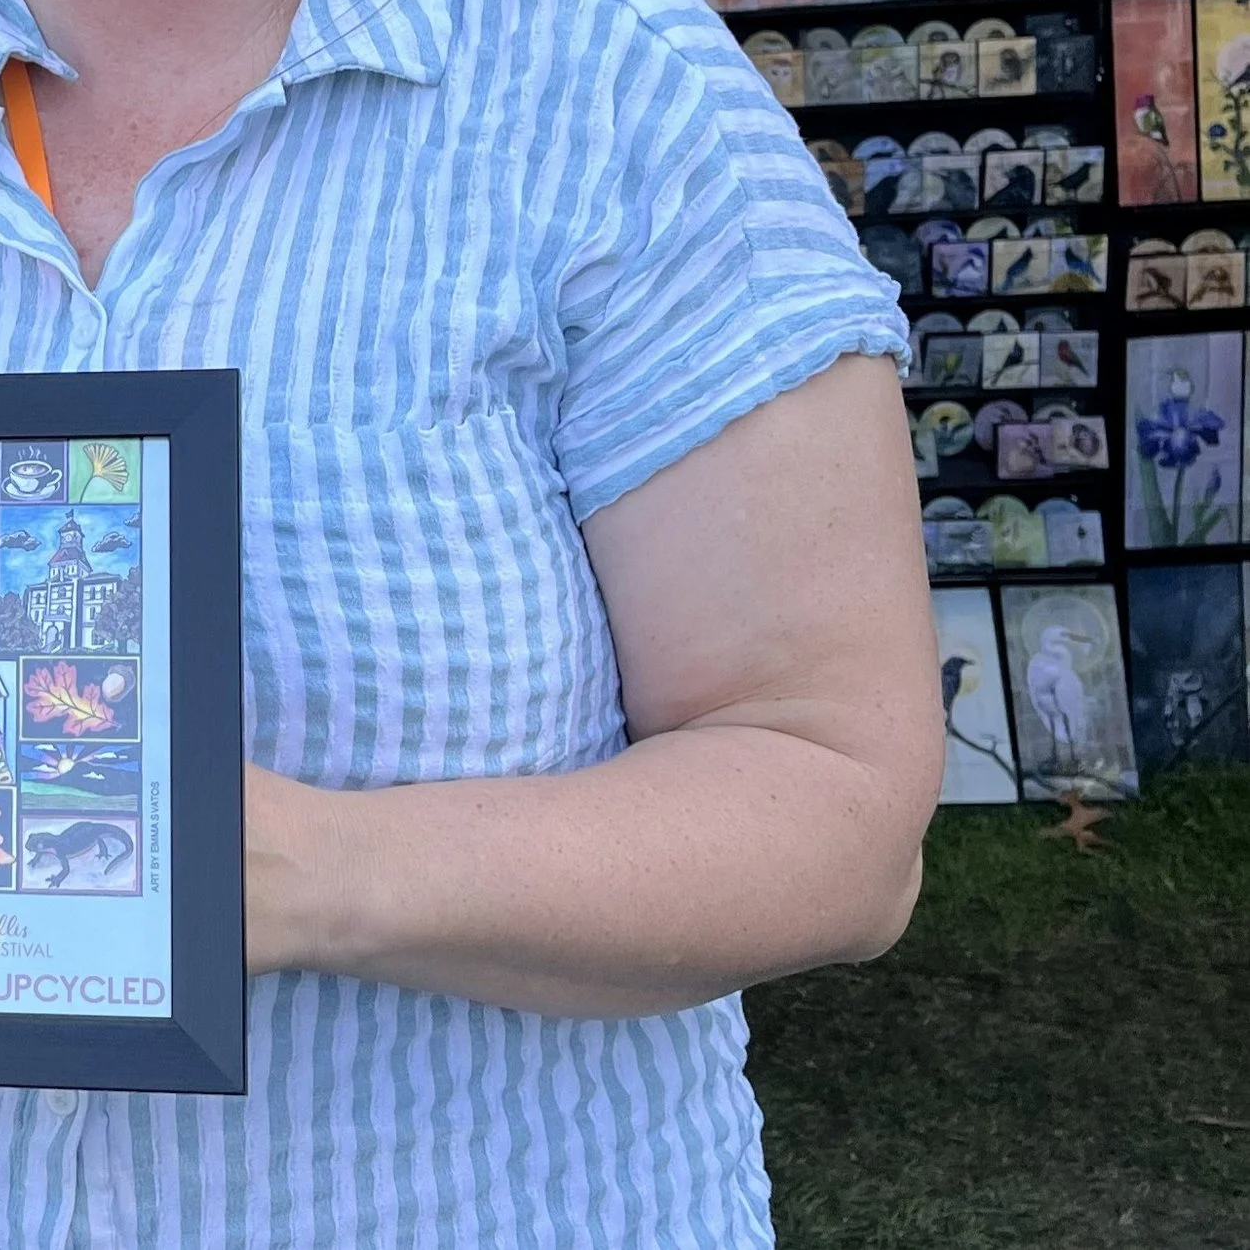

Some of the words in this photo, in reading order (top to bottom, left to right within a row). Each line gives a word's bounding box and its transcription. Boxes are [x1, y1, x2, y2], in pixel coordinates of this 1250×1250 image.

[150, 781, 160, 821] SVATOS
[150, 822, 160, 854] EMMA
[150, 856, 160, 870] BY
[150, 872, 160, 892] ART
